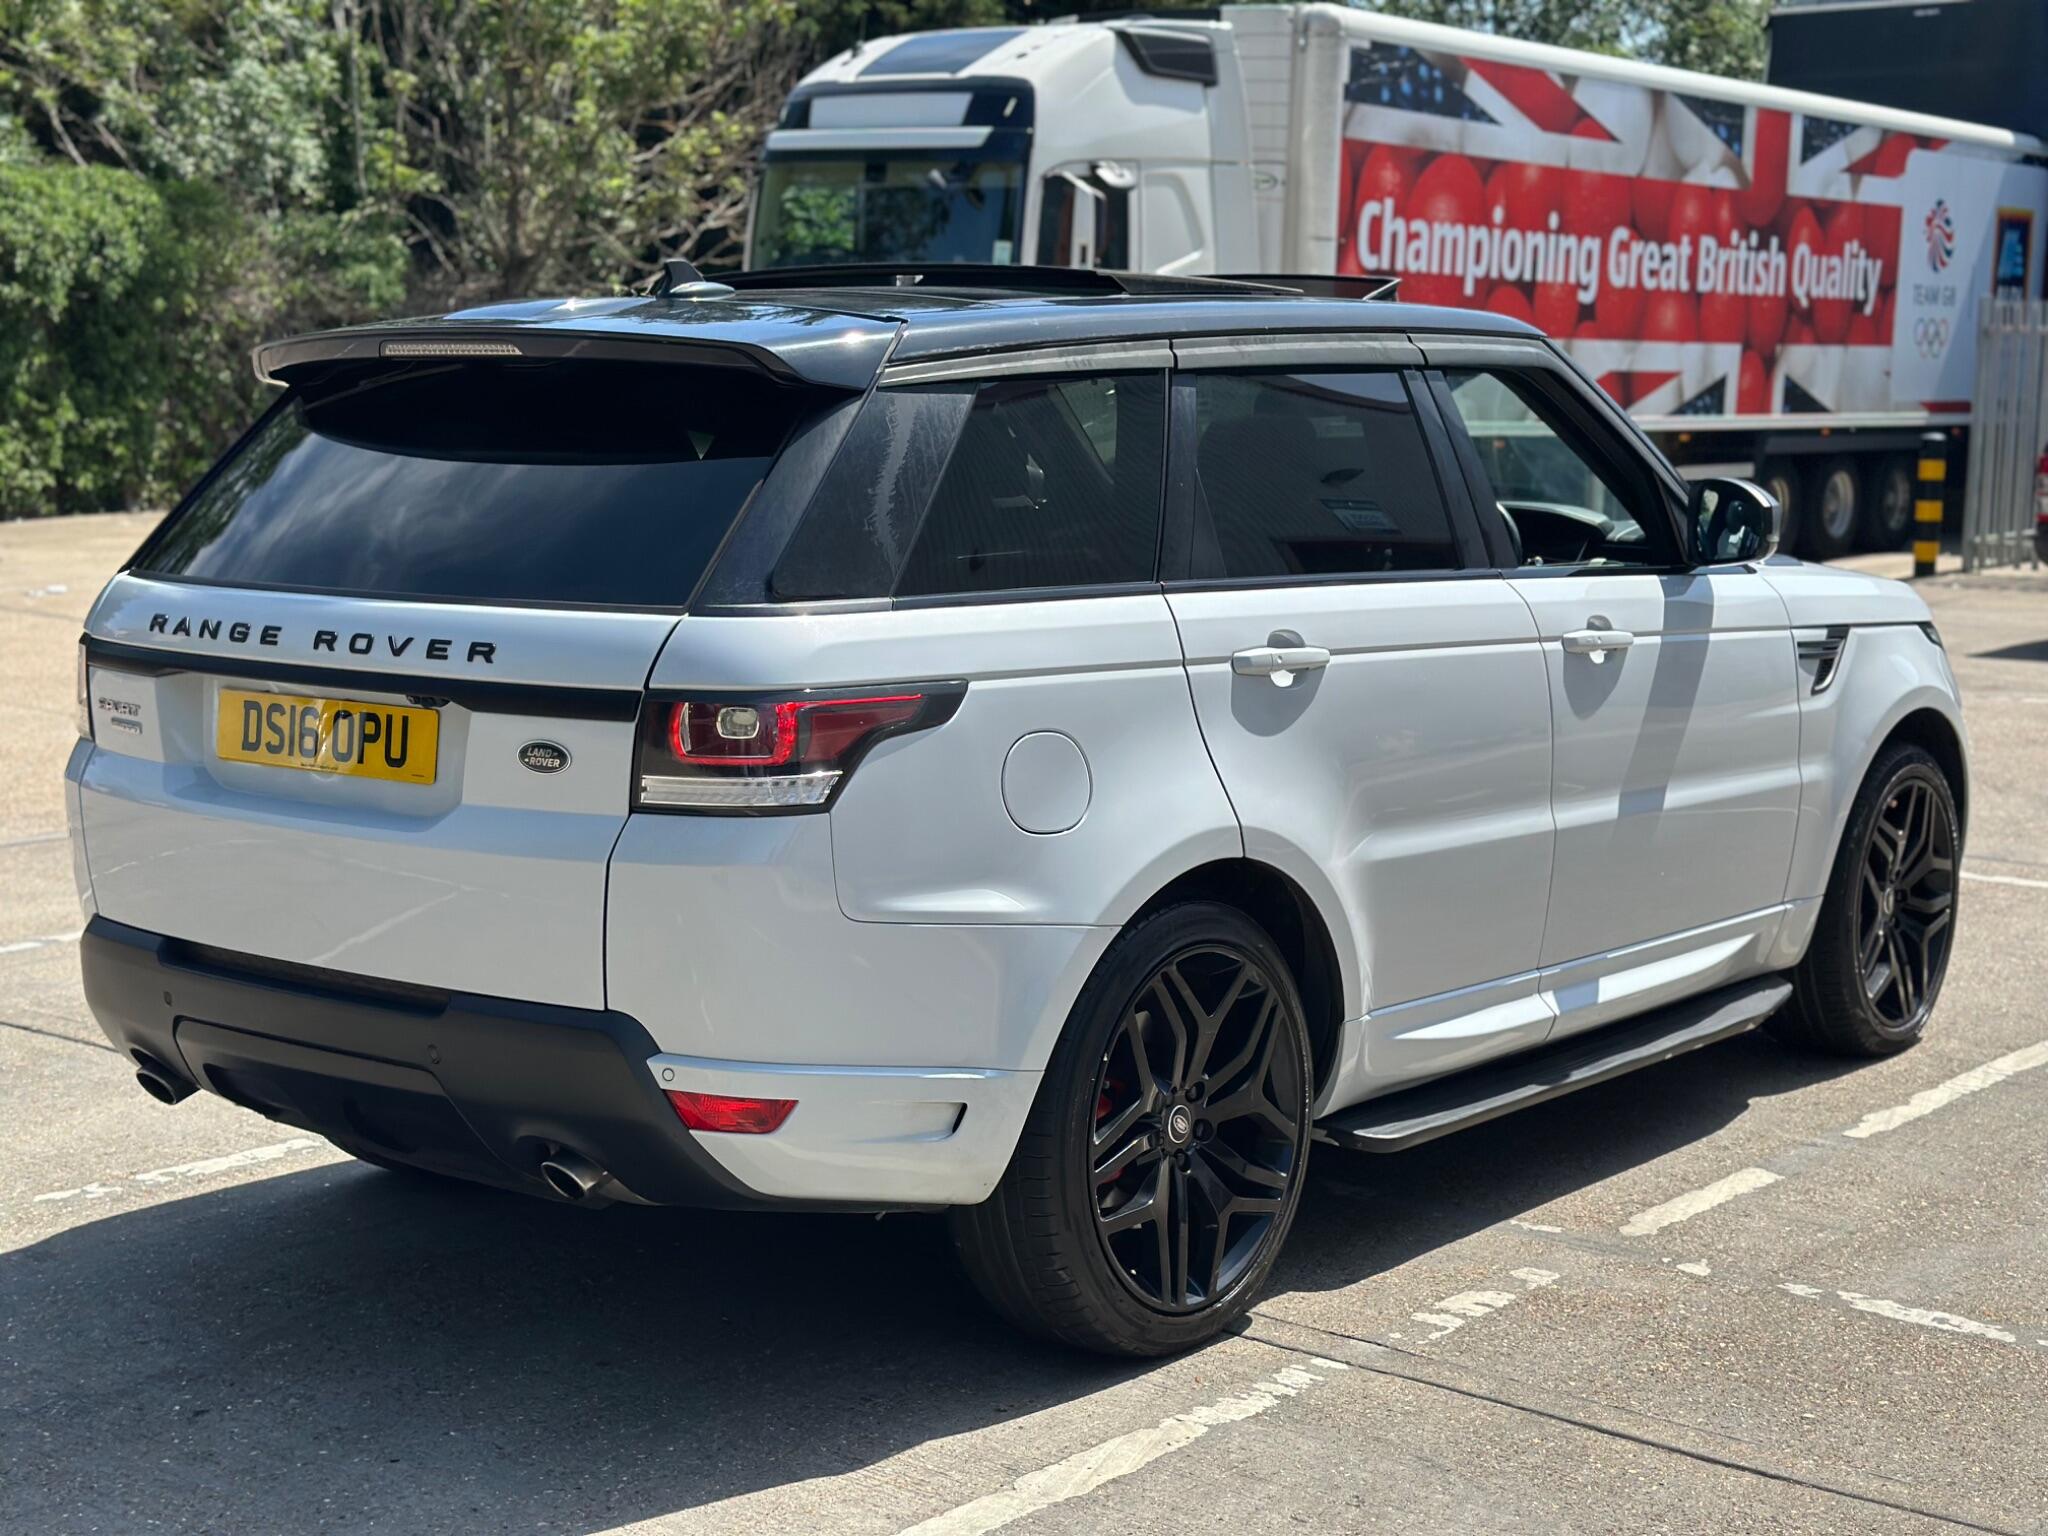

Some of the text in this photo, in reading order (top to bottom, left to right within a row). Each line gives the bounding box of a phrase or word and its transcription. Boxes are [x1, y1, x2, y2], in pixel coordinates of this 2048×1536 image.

[1358, 197, 1882, 316] Championing Great British Quality
[149, 613, 497, 664] RANGE ROVER
[527, 747, 552, 758] LAND
[530, 757, 560, 768] ROVER
